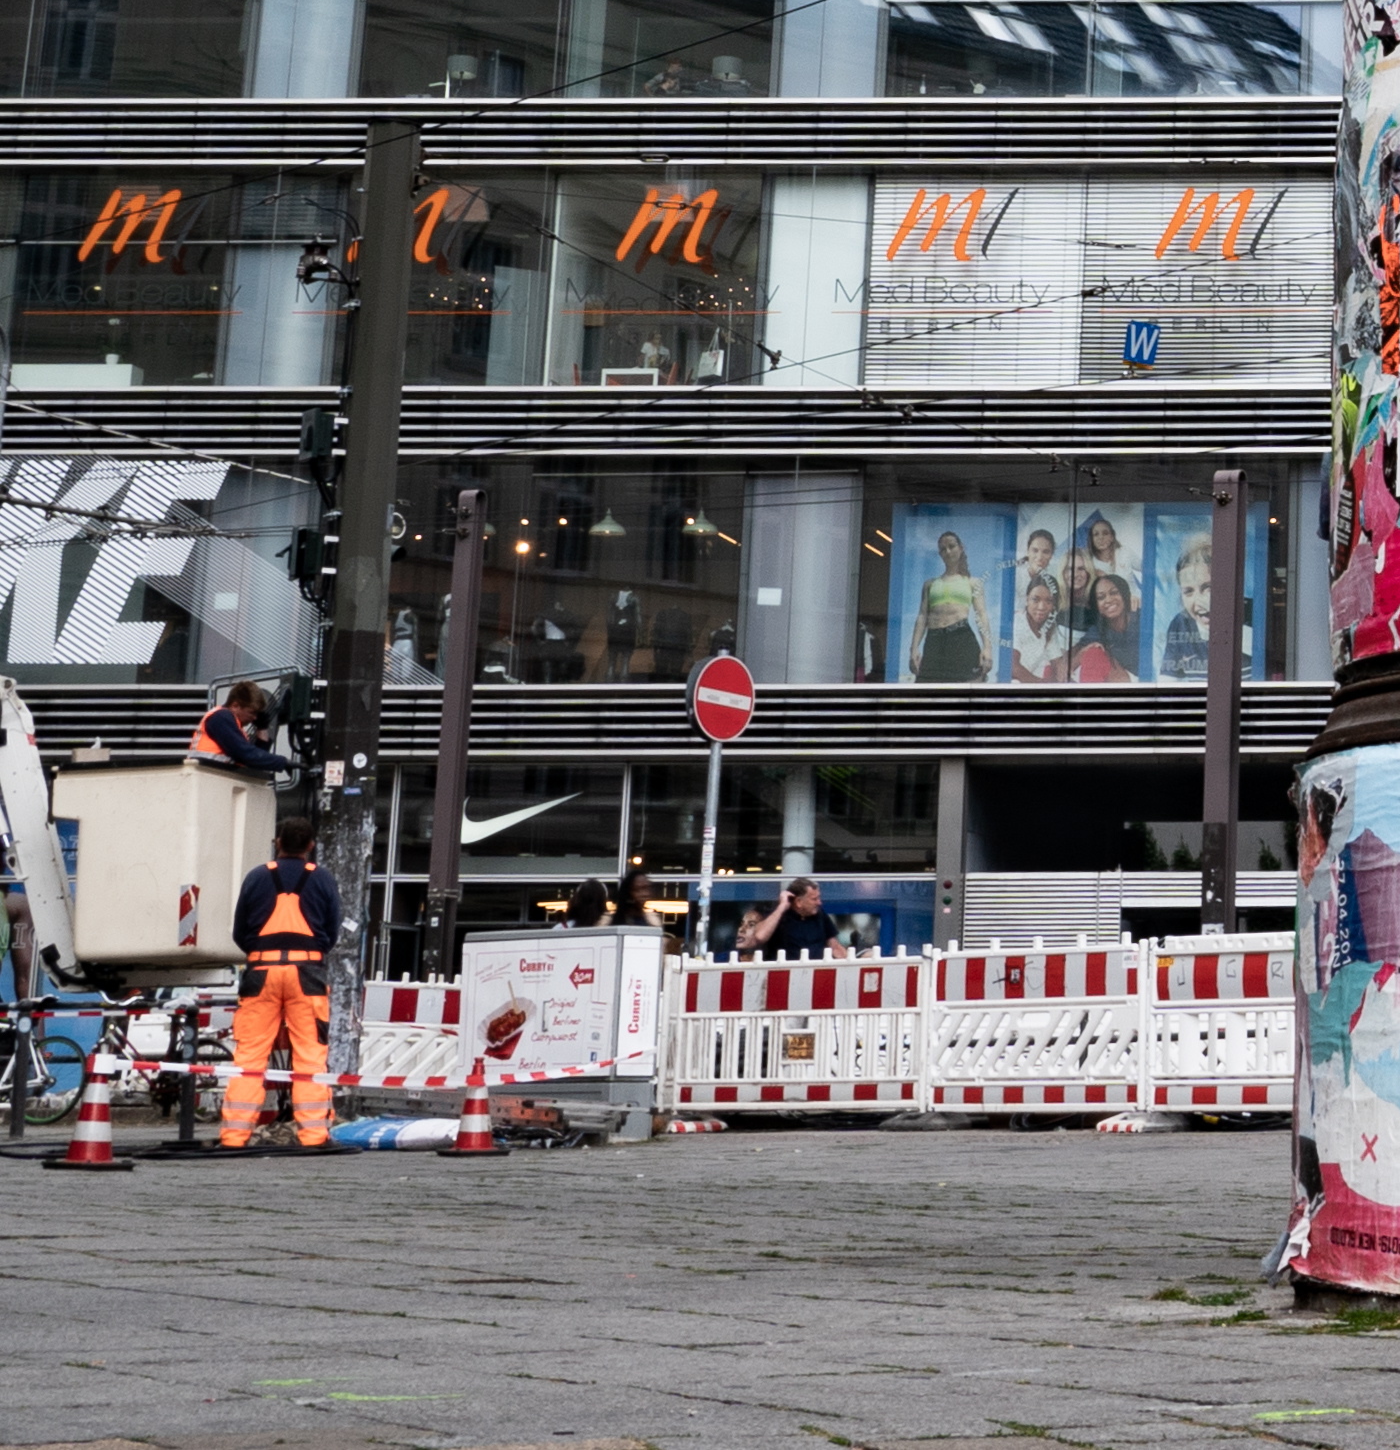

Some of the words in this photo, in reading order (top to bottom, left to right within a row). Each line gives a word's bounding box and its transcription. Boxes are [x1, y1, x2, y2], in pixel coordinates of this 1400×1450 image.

[834, 277, 916, 304] Med
[922, 277, 1051, 307] Beauty
[1101, 277, 1183, 304] Med
[1190, 277, 1318, 307] Beauty
[1128, 323, 1159, 361] W
[519, 958, 547, 972] CURRY
[627, 991, 642, 1034] CURRY
[518, 1057, 547, 1070] Berlin
